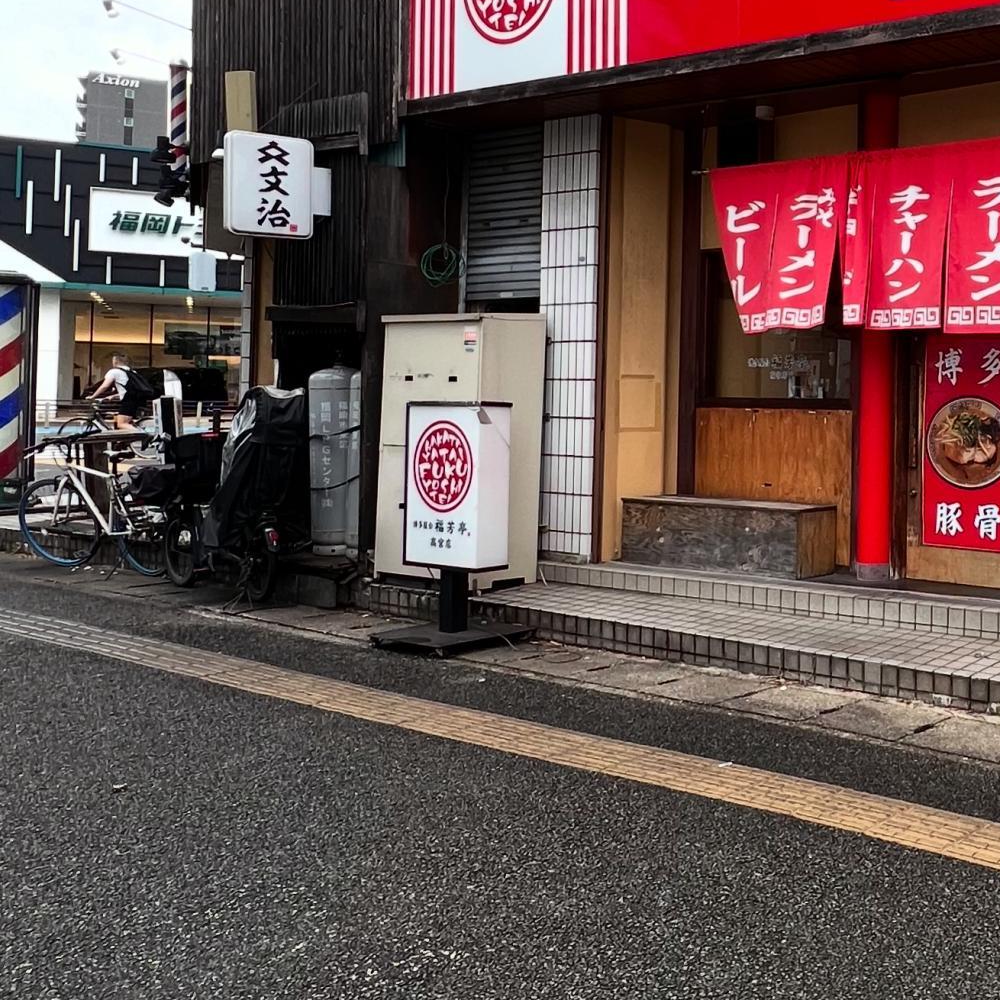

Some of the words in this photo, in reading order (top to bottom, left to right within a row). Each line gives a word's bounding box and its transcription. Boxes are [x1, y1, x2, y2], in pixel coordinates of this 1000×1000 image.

[487, 10, 526, 31] TEI
[92, 72, 140, 89] Axion
[725, 200, 766, 307] ビール
[778, 193, 819, 300] ラーメン
[884, 184, 931, 303] チャーハン
[418, 458, 468, 480] FUKU
[422, 477, 463, 495] YOSHI
